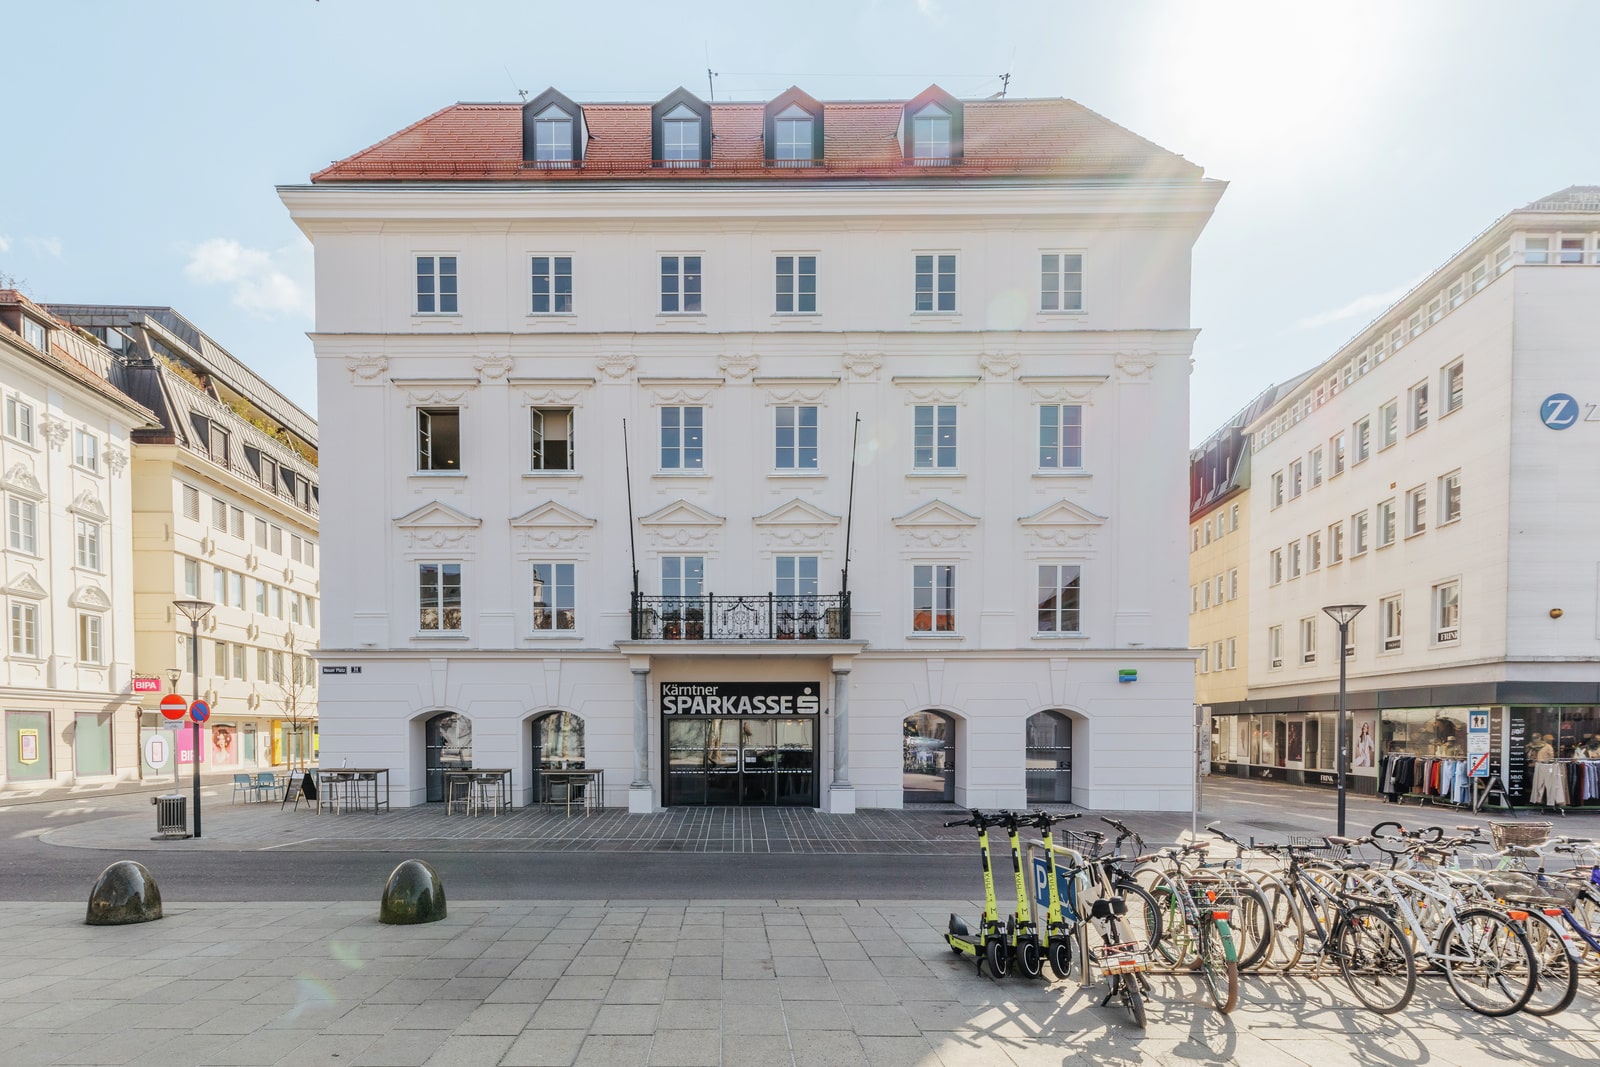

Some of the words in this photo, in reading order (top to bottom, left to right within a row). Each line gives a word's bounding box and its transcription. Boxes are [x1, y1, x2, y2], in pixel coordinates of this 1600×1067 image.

[135, 681, 157, 689] BIPA
[663, 684, 719, 696] Kärntner
[663, 696, 793, 714] SPARKASSE
[180, 750, 202, 761] BIP
[1036, 864, 1047, 900] P
